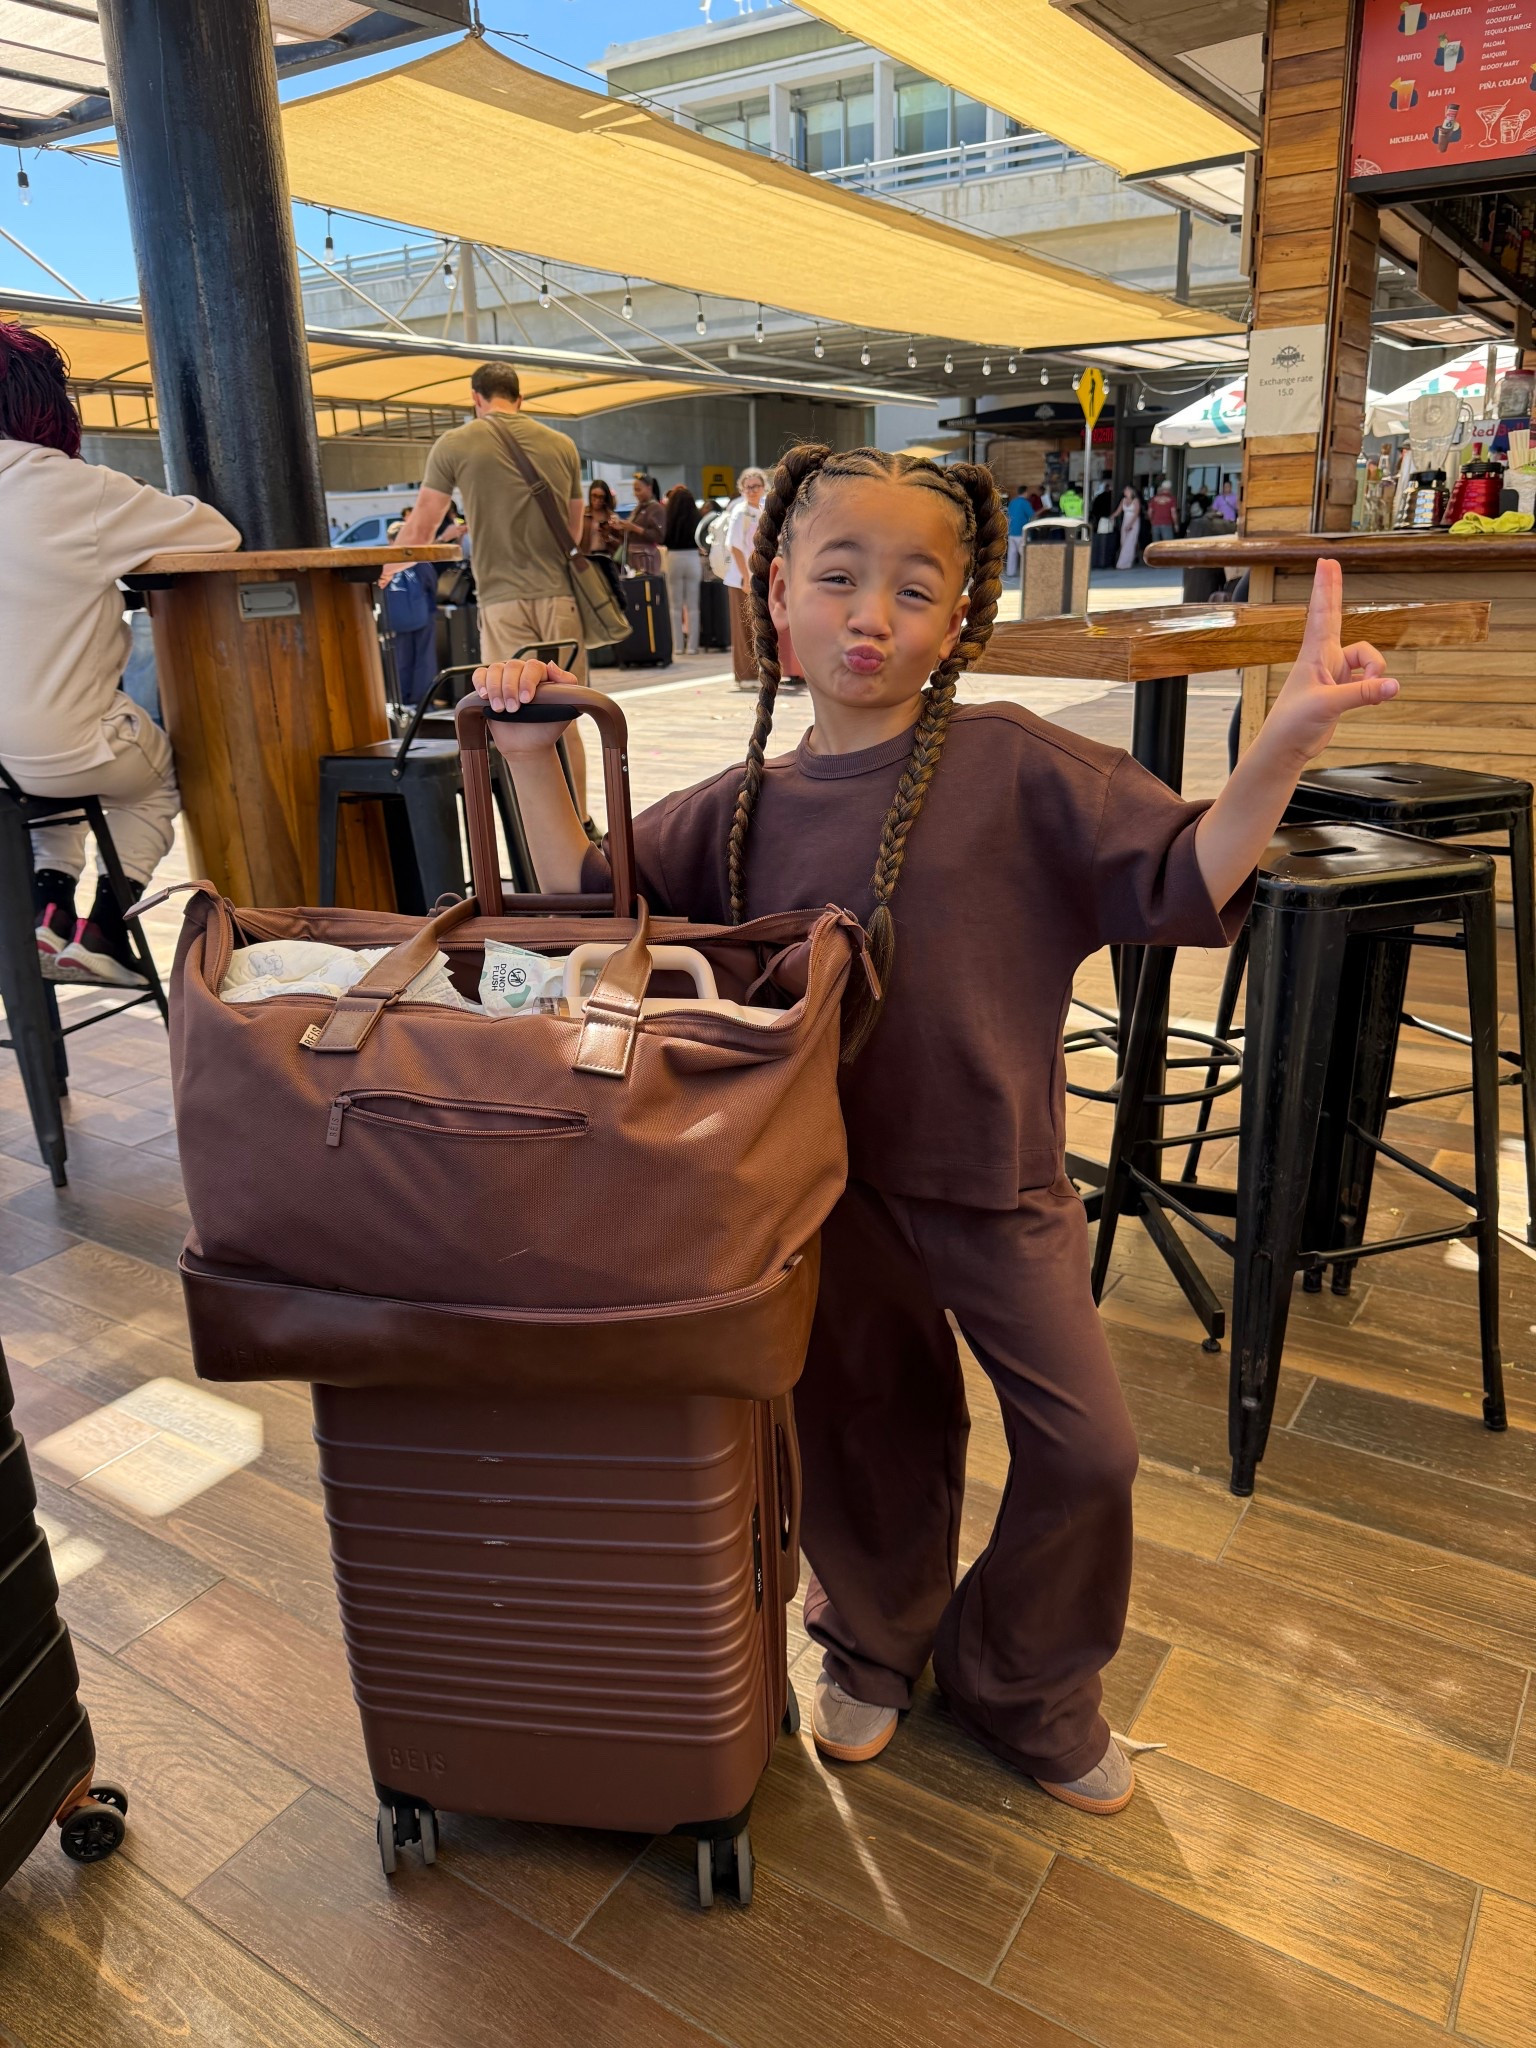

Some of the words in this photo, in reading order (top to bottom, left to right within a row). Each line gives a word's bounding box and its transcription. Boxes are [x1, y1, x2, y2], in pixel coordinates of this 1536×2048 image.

[1429, 6, 1472, 21] MARGARITA
[1486, 3, 1517, 14] MEZCALITA
[1485, 15, 1512, 25] GOODBYE
[1484, 27, 1507, 36] TEQUILA
[1508, 23, 1532, 33] SUNRISE
[1482, 40, 1505, 48] PALOMA
[1396, 52, 1422, 63] MOJITO
[1480, 62, 1503, 71] BLOODY
[1503, 60, 1520, 68] MARY
[1478, 80, 1497, 91] PIÑA
[1498, 76, 1528, 87] COLADA
[1427, 89, 1442, 98] MAI
[1444, 86, 1456, 95] TAI
[1389, 132, 1429, 145] MICHELADA
[1259, 376, 1296, 387] Exchange
[1296, 375, 1314, 384] rate
[1278, 388, 1294, 397] 15.0
[499, 963, 507, 975] DO
[491, 965, 500, 992] FLUSH
[498, 976, 506, 993] NOT
